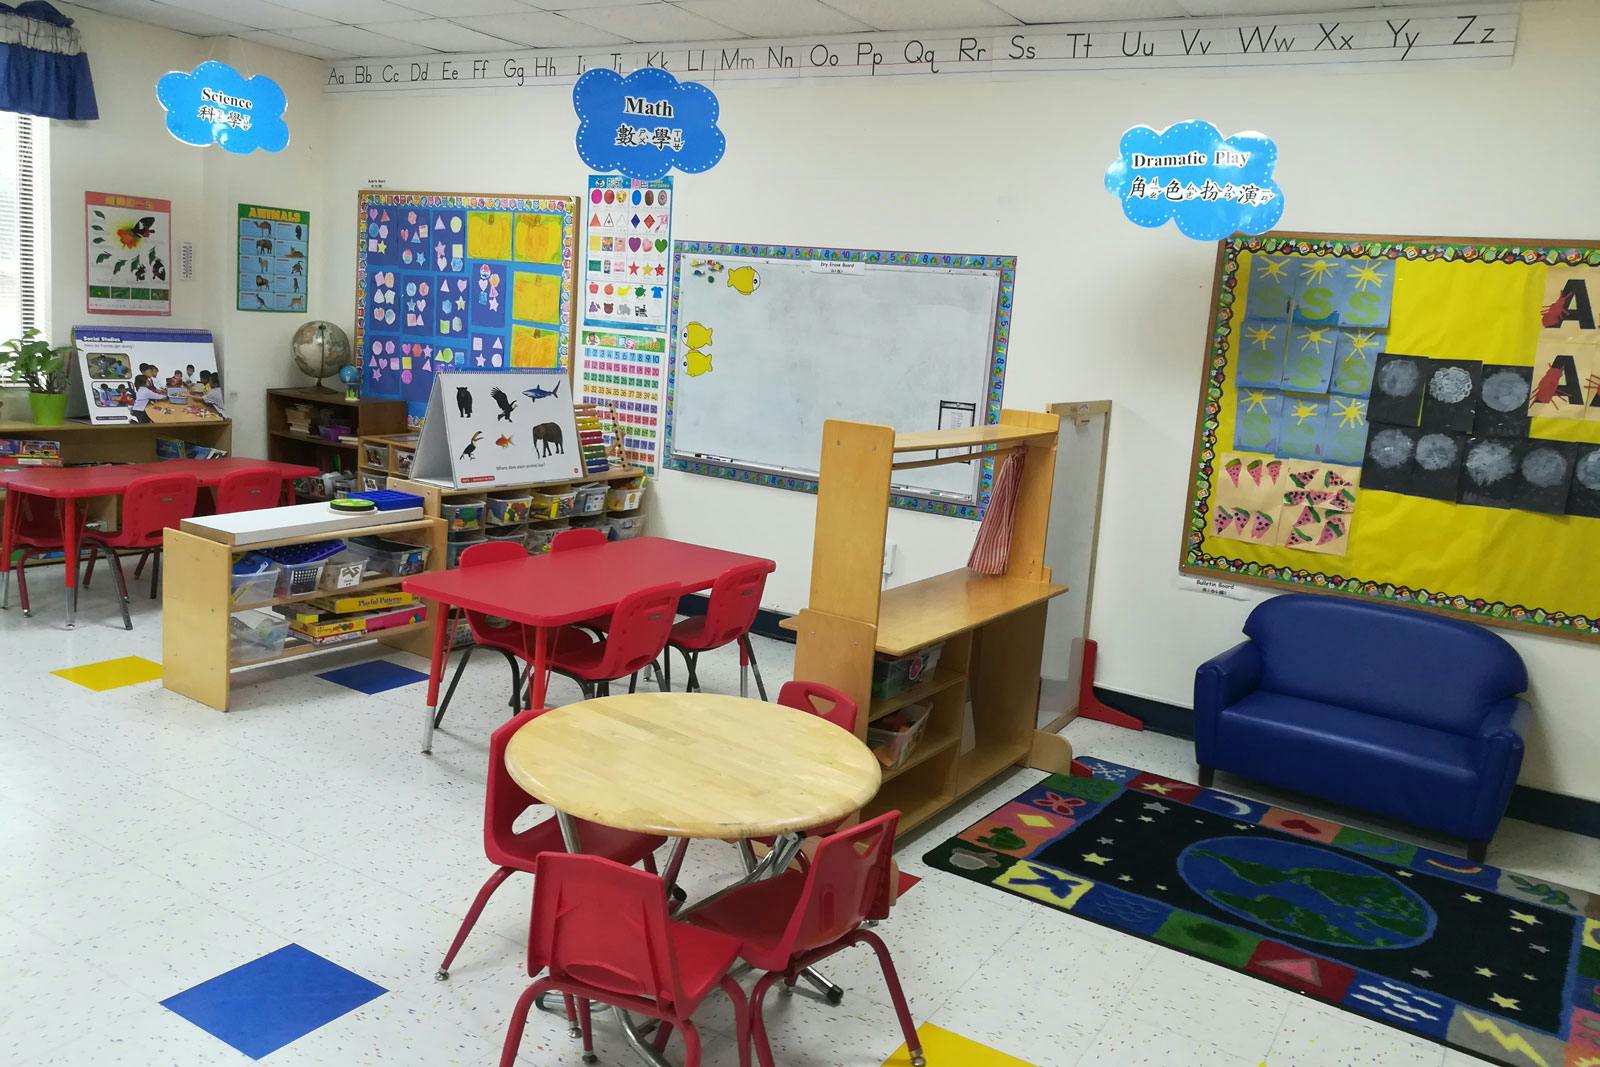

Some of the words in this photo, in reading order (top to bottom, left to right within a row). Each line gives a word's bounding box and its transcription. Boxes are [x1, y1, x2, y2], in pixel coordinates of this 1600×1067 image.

[328, 68, 344, 84] Aa
[355, 66, 372, 83] Bb
[382, 65, 399, 82] Cc
[411, 63, 429, 81] Dd
[442, 62, 458, 80] Ee
[474, 60, 489, 79] Ff
[504, 59, 524, 86] Gg
[536, 57, 555, 77] Hh
[648, 52, 668, 71] Kk
[688, 50, 704, 71] Ll
[720, 48, 754, 70] Mm
[768, 47, 793, 69] Nn
[810, 44, 838, 66] Oo
[857, 42, 882, 76] Pp
[904, 40, 939, 73] Qq
[959, 38, 985, 61] Rr
[1008, 36, 1035, 59] Ss
[1067, 34, 1092, 58] Tt
[1122, 31, 1153, 57] Uu
[1181, 29, 1211, 55] Vv
[1238, 25, 1294, 53] Ww
[1315, 23, 1353, 50] Xx
[1386, 19, 1420, 61] Yy
[1453, 16, 1495, 44] Zz
[202, 90, 252, 109] Science
[625, 97, 672, 116] Math
[1134, 152, 1205, 167] Dramatic
[1216, 152, 1248, 166] Play
[1301, 288, 1333, 320] S
[1347, 291, 1381, 324] S
[1291, 355, 1323, 388] S
[1336, 357, 1368, 393] S
[1241, 413, 1271, 446] S
[358, 599, 378, 607] Playful
[380, 597, 402, 605] Patterns
